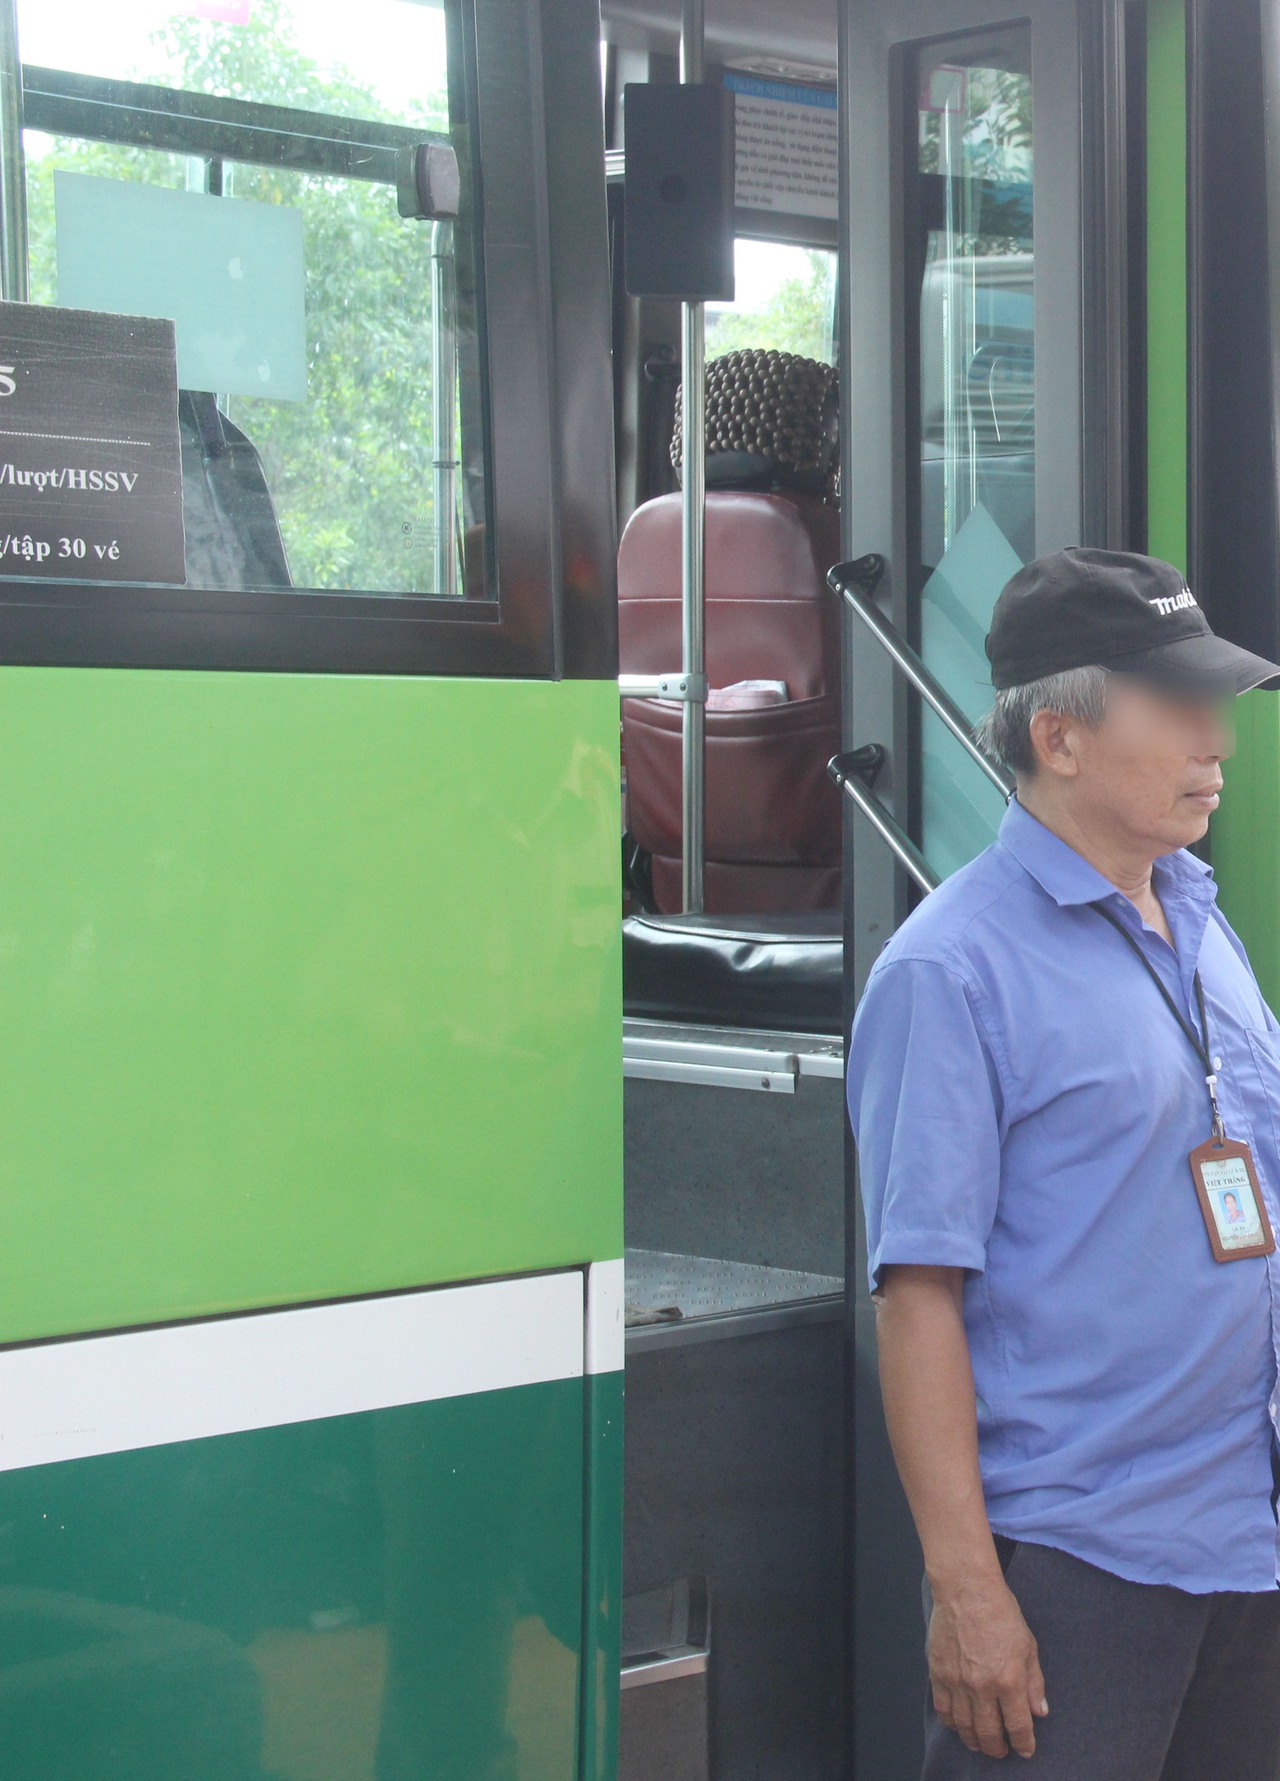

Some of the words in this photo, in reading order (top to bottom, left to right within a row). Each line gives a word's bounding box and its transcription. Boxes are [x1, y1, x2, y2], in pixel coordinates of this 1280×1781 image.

[0, 534, 50, 561] /tập
[58, 537, 87, 559] 30
[94, 540, 121, 560] vé
